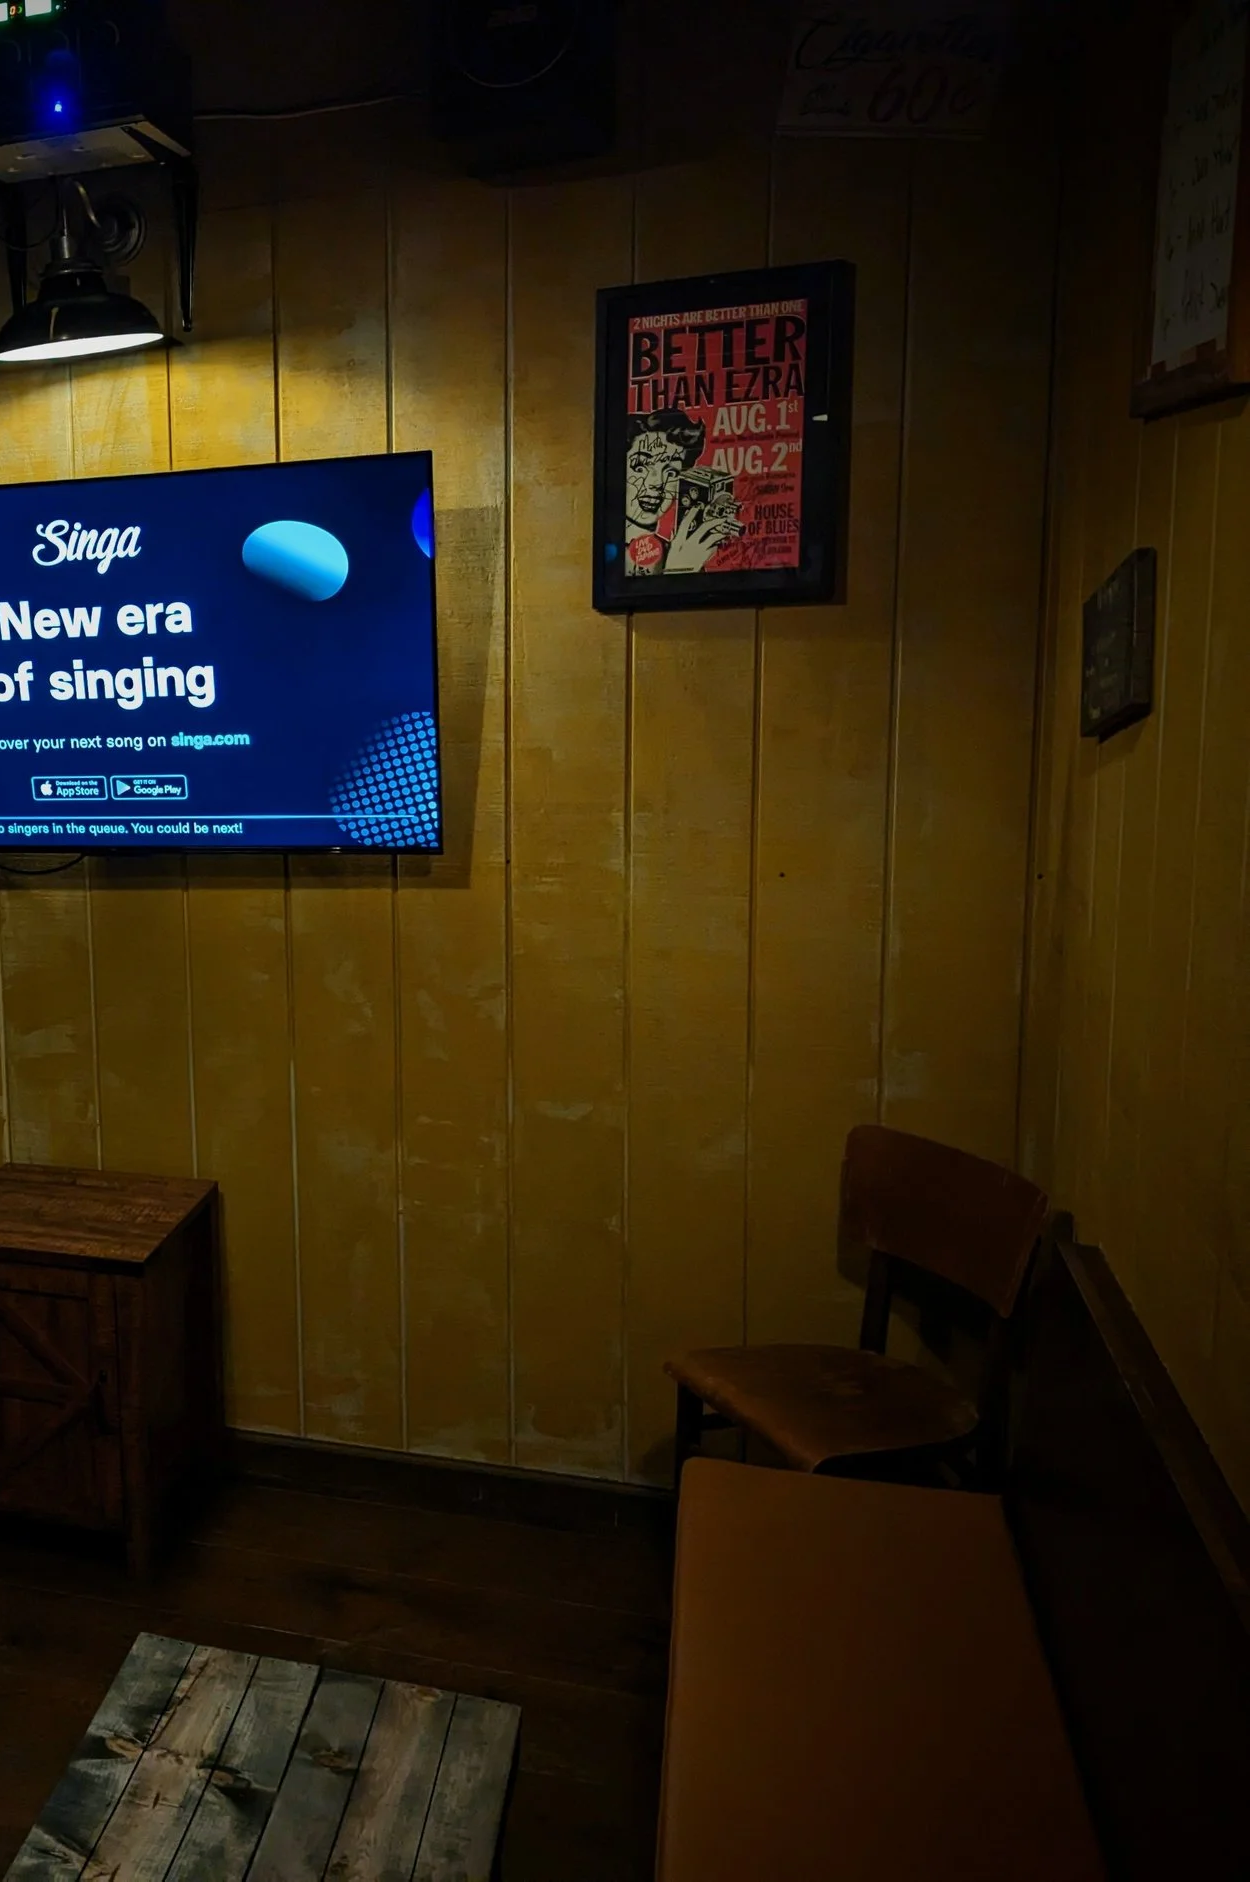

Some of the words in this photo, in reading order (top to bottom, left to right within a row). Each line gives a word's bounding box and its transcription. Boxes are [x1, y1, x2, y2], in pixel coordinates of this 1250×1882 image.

[633, 319, 641, 330] 2
[641, 315, 680, 329] NIGHTS
[682, 311, 703, 325] ARE
[705, 306, 747, 321] BETTER
[749, 302, 779, 316] THAN
[781, 300, 805, 314] ONE
[631, 315, 806, 378] BETTER
[631, 372, 714, 412] THAN
[725, 363, 806, 403] EZRA
[712, 402, 772, 436] AUG.
[776, 400, 799, 431] 1st
[711, 444, 769, 478] AUG.
[770, 437, 803, 472] 2nd
[748, 521, 764, 535] OF
[765, 518, 799, 534] BLUES
[754, 503, 795, 520] HOUSE
[32, 518, 141, 574] Singa
[116, 600, 193, 634] era
[49, 656, 216, 710] singing
[33, 739, 66, 753] your
[70, 736, 102, 749] next
[106, 735, 143, 751] song
[147, 734, 167, 747] on
[171, 732, 250, 750] singa.com
[56, 787, 76, 797] App
[76, 786, 99, 796] Store
[133, 785, 164, 796] Google
[164, 785, 182, 796] Play
[8, 823, 49, 837] singers
[52, 823, 63, 834] in
[66, 823, 86, 834] the
[89, 825, 129, 837] queue.
[131, 822, 153, 834] You
[156, 822, 190, 834] could
[194, 822, 209, 834] be
[213, 822, 243, 834] next!
